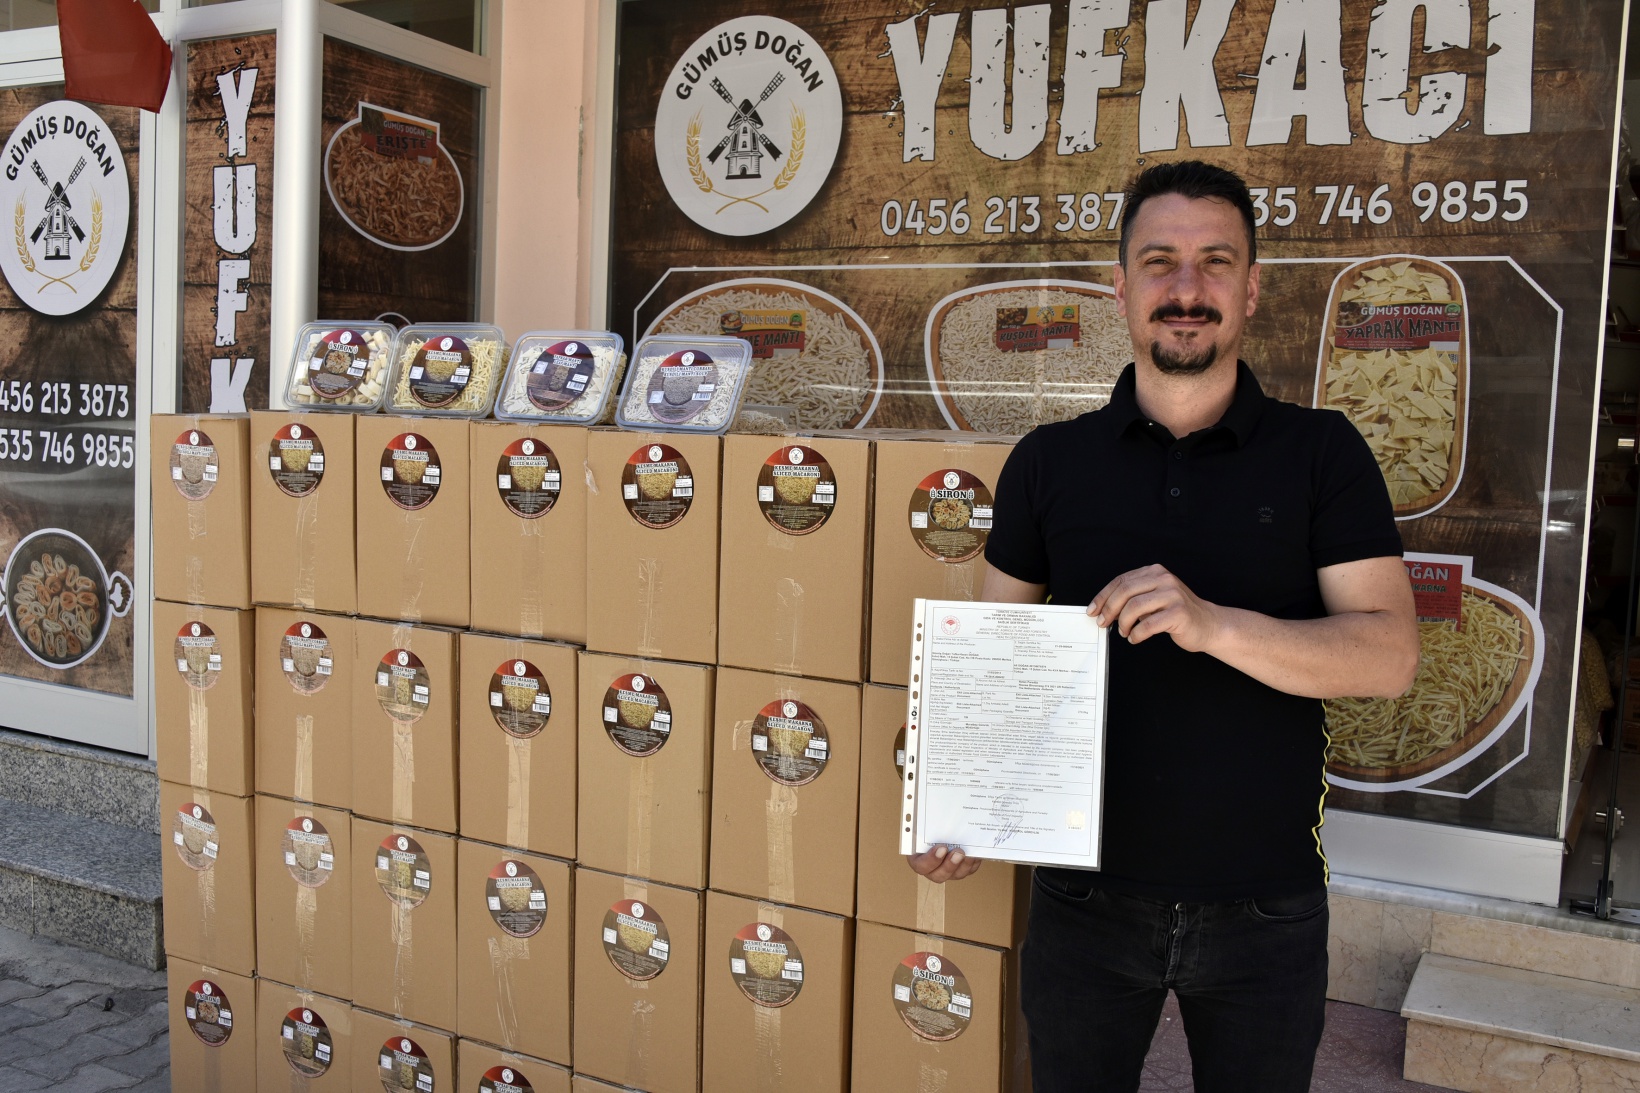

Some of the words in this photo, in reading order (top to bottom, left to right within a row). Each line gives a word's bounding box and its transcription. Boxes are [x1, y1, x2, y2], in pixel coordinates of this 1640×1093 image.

[676, 32, 747, 100] GÜMÜŞ
[754, 31, 824, 93] DOĞAN
[879, 0, 1532, 163] YUFKACI
[6, 116, 58, 181] GÜMÜŞ
[63, 115, 115, 177] DOĞAN
[376, 134, 427, 151] ERİŞTE
[1315, 183, 1392, 225] 746
[1411, 179, 1528, 223] 9855
[881, 198, 970, 236] 0456
[984, 195, 1041, 233] 213
[1360, 304, 1400, 317] GÜMÜŞ
[1403, 304, 1443, 316] DOĞAN
[763, 330, 800, 346] MANTI
[1042, 324, 1073, 337] MANTI
[1345, 318, 1405, 339] YAPRAK
[1408, 318, 1460, 338] MANTI
[40, 381, 71, 415] 213
[79, 383, 129, 418] 3873
[40, 431, 75, 464] 746
[82, 435, 134, 469] 9855
[937, 488, 968, 499] SİRON
[1411, 583, 1446, 593] KARNA
[919, 969, 948, 985] SİRON
